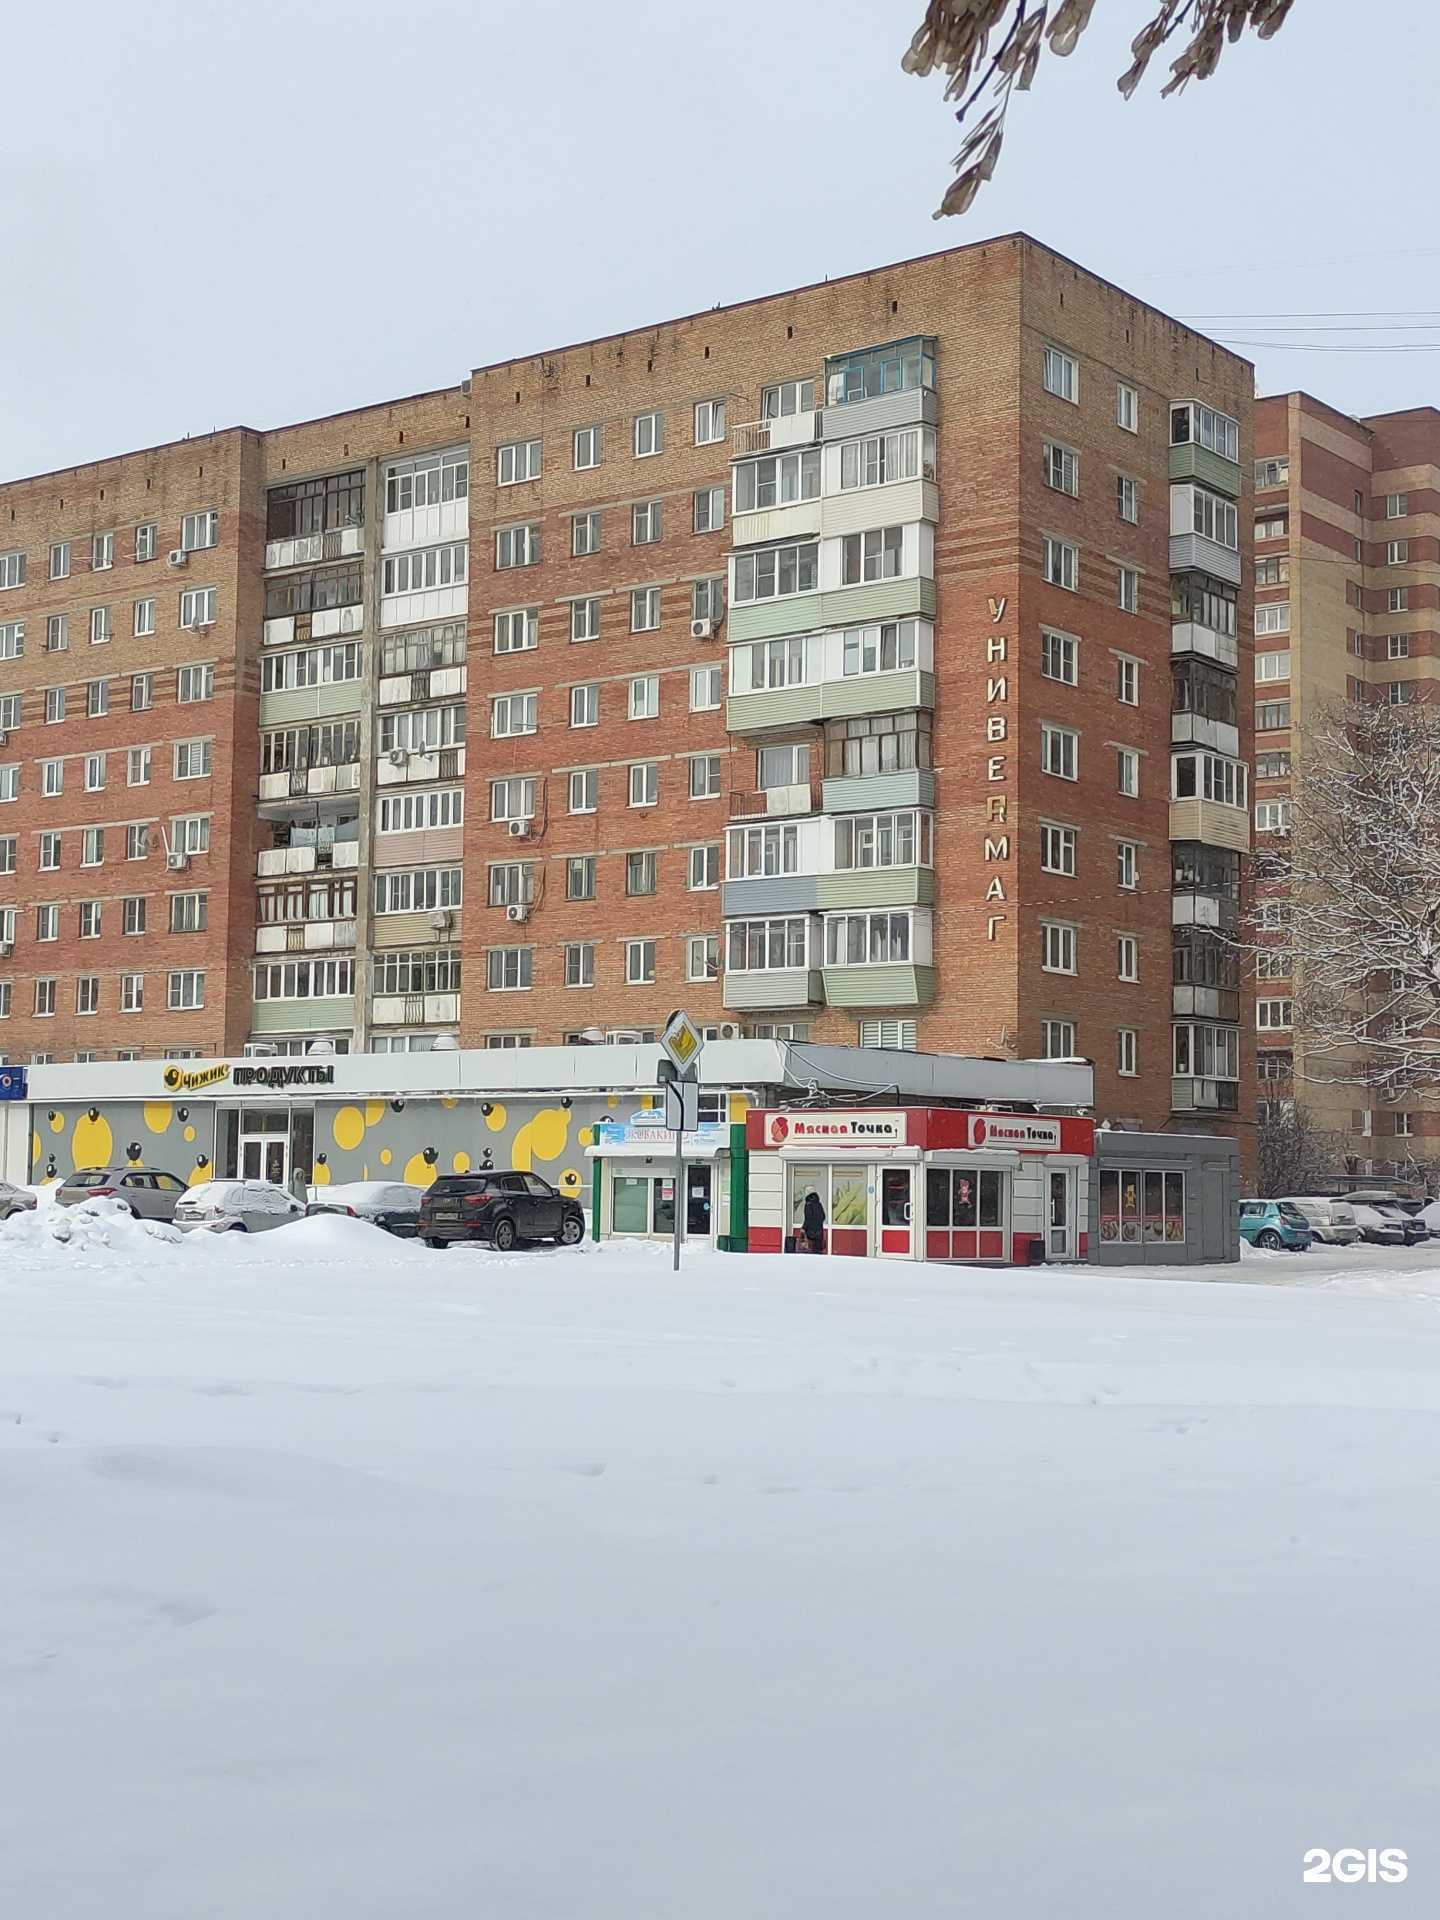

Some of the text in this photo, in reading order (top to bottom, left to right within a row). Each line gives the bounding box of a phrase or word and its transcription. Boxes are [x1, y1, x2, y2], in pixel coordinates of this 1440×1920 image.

[984, 597, 1008, 942] УНИВЕРМАГ
[233, 1065, 334, 1089] ПРОДУКТЫ
[794, 1121, 893, 1134] Мясная Точка
[989, 1124, 1054, 1140] Мясная Точка
